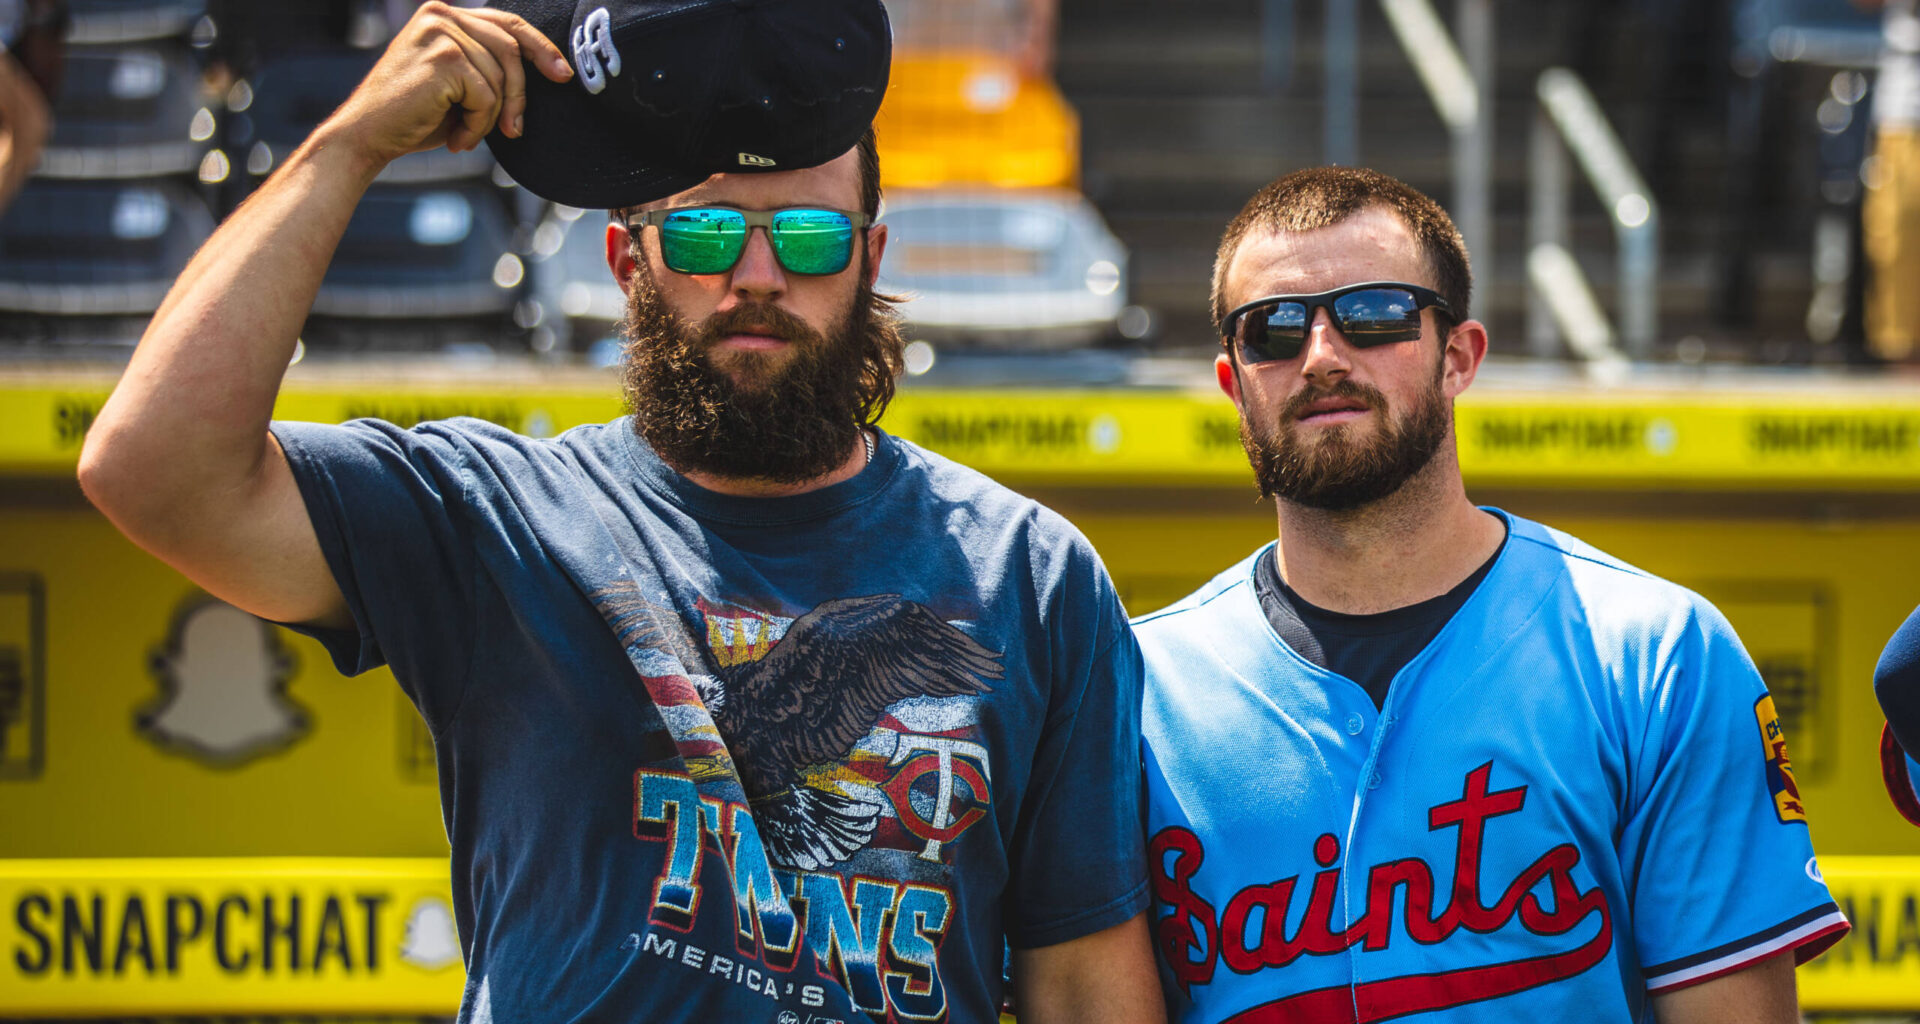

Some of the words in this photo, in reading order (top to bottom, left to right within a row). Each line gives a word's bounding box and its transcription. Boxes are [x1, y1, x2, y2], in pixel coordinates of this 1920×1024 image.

[1150, 759, 1612, 1001] Saints
[14, 893, 392, 974] SNAPCHAT
[621, 932, 825, 1008] AMERICA'S
